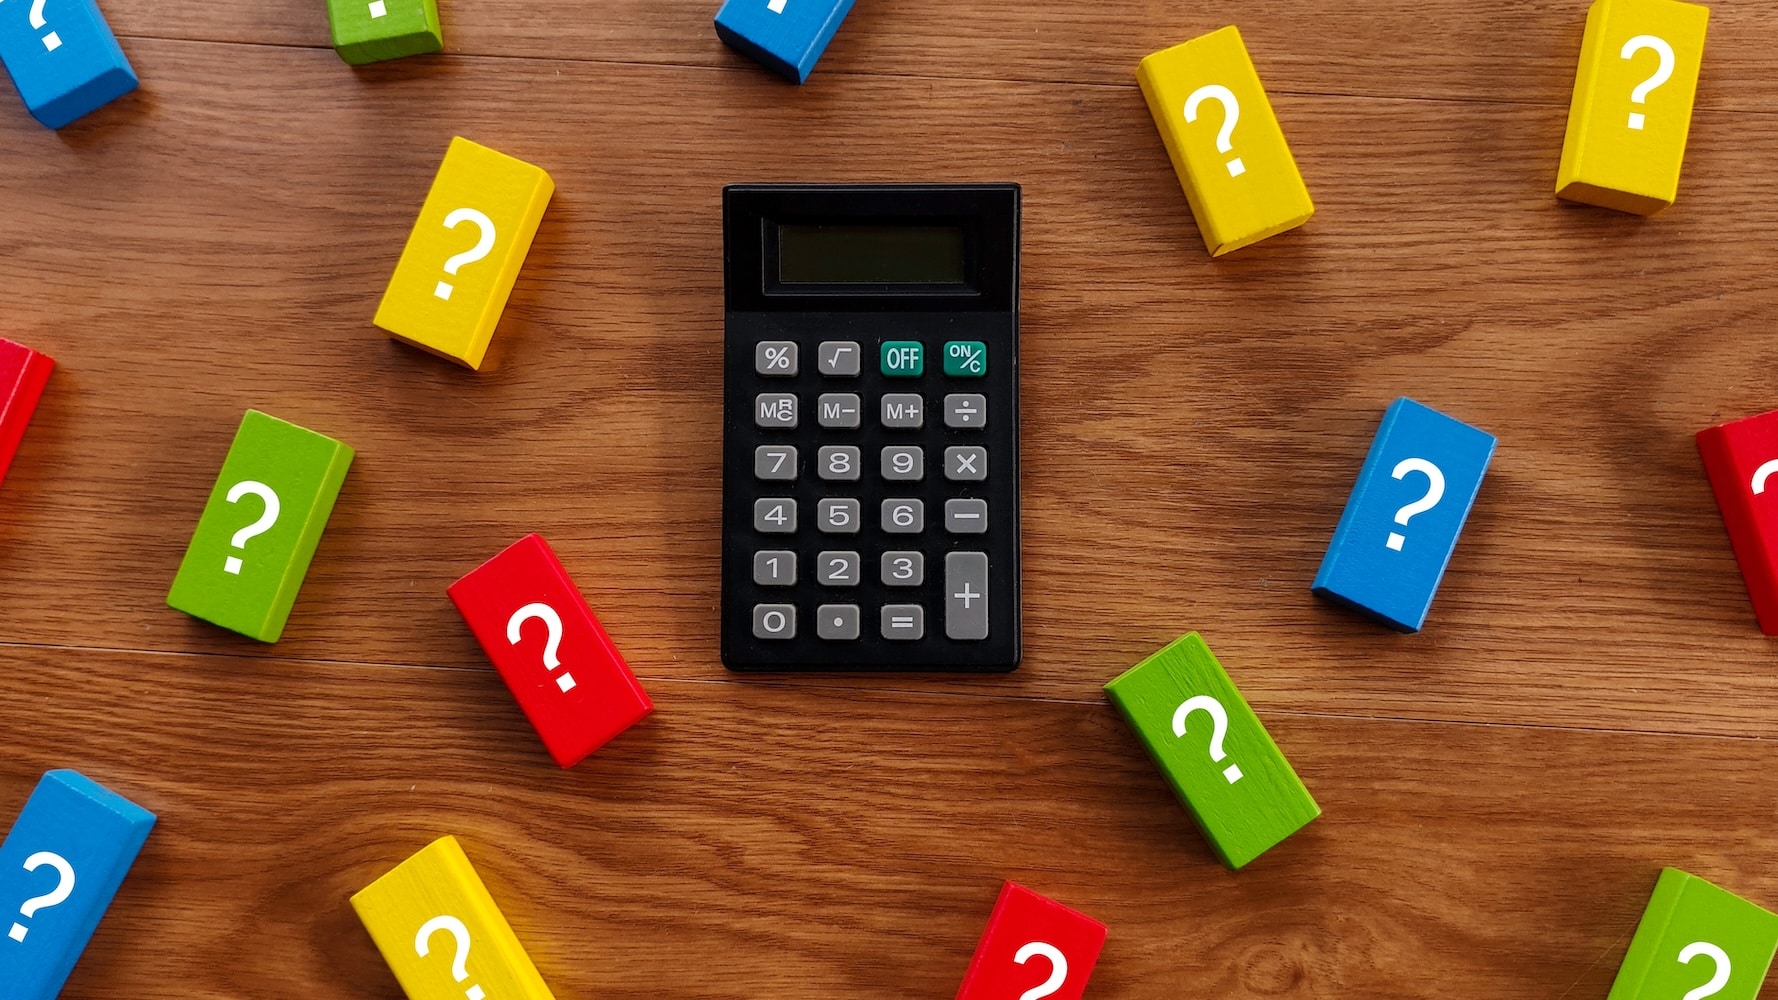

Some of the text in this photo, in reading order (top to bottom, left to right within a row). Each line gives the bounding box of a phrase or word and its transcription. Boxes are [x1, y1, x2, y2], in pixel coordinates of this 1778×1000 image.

[1621, 35, 1675, 130] ?
[1183, 85, 1245, 177] ?
[434, 208, 496, 300] ?
[764, 346, 790, 370] %
[886, 348, 919, 370] OFF
[886, 403, 919, 420] M+
[766, 452, 787, 472] 7
[828, 452, 850, 473] 8
[892, 452, 914, 474] 9
[764, 505, 788, 526] 4
[828, 505, 850, 526] 5
[892, 505, 914, 526] 6
[1386, 458, 1445, 551] ?
[224, 480, 280, 574] ?
[766, 558, 778, 578] 1
[828, 558, 850, 580] 2
[892, 558, 914, 578] 3
[762, 610, 786, 632] 0
[506, 603, 577, 693] ?
[1172, 695, 1243, 784] ?
[8, 851, 75, 942] ?
[415, 915, 485, 1000] ?
